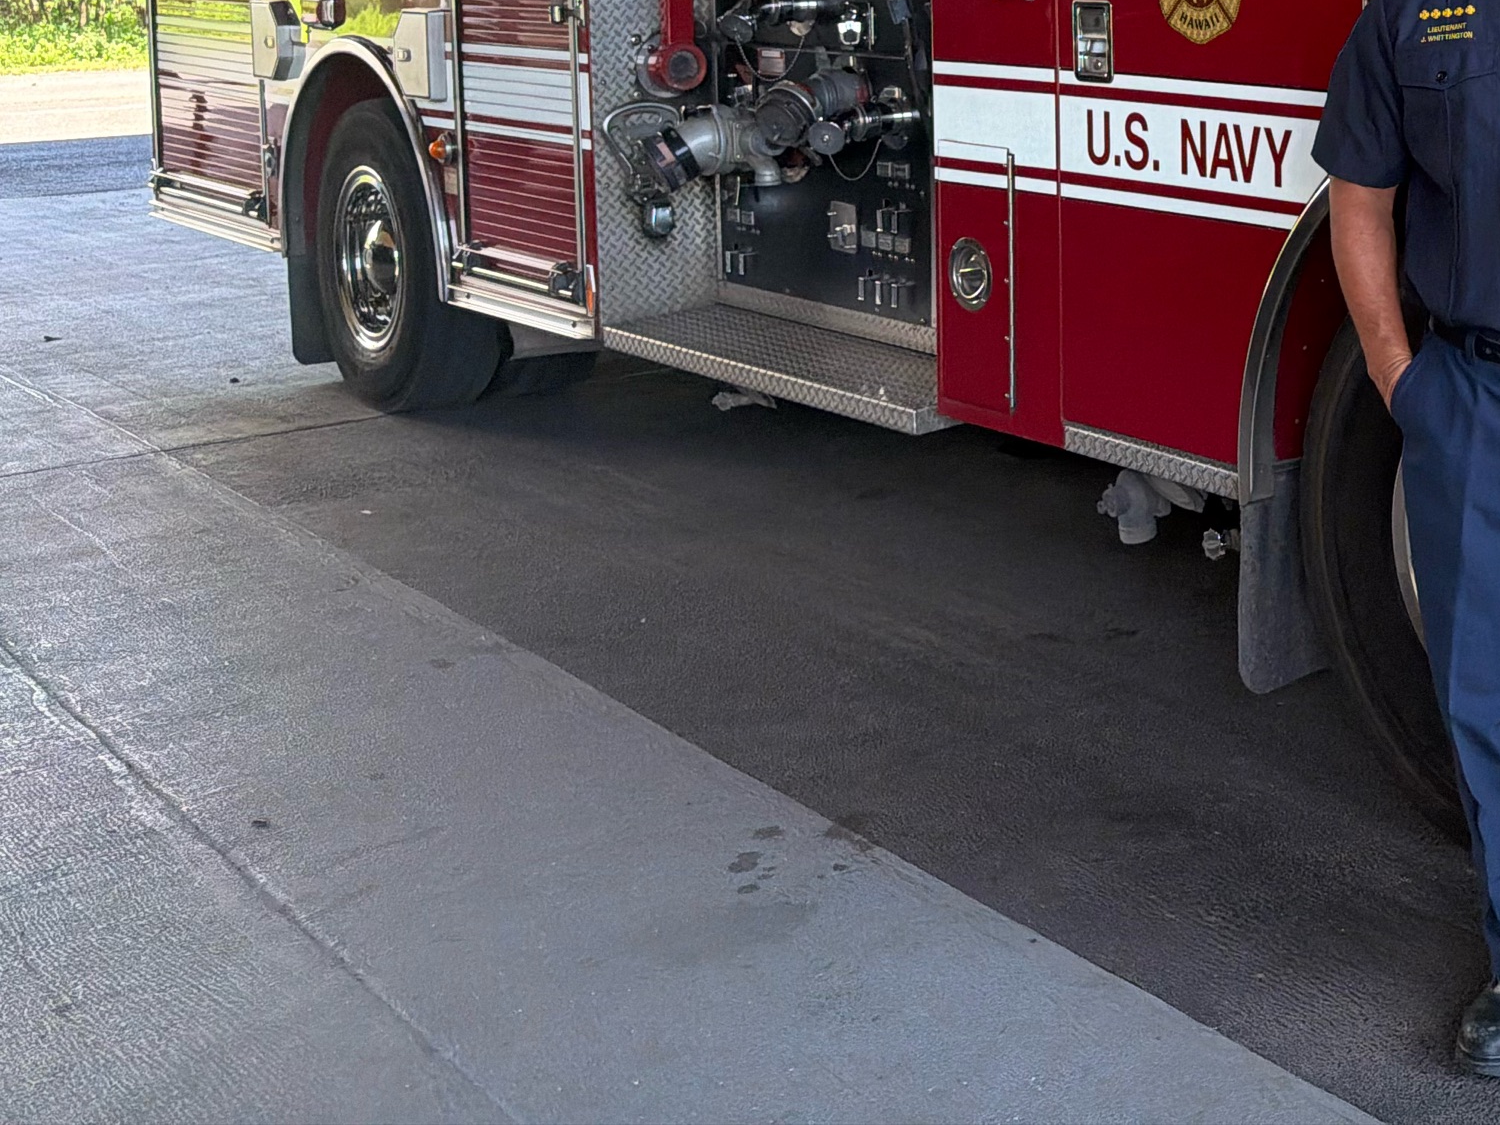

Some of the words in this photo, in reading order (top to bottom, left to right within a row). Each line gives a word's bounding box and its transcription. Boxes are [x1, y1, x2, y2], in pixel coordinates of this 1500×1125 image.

[1179, 11, 1220, 31] HAWAII
[1427, 22, 1467, 33] LIEUTENANT
[1427, 31, 1473, 43] WHITTINGTON
[1087, 108, 1160, 172] U.S.
[1180, 118, 1293, 188] NAVY
